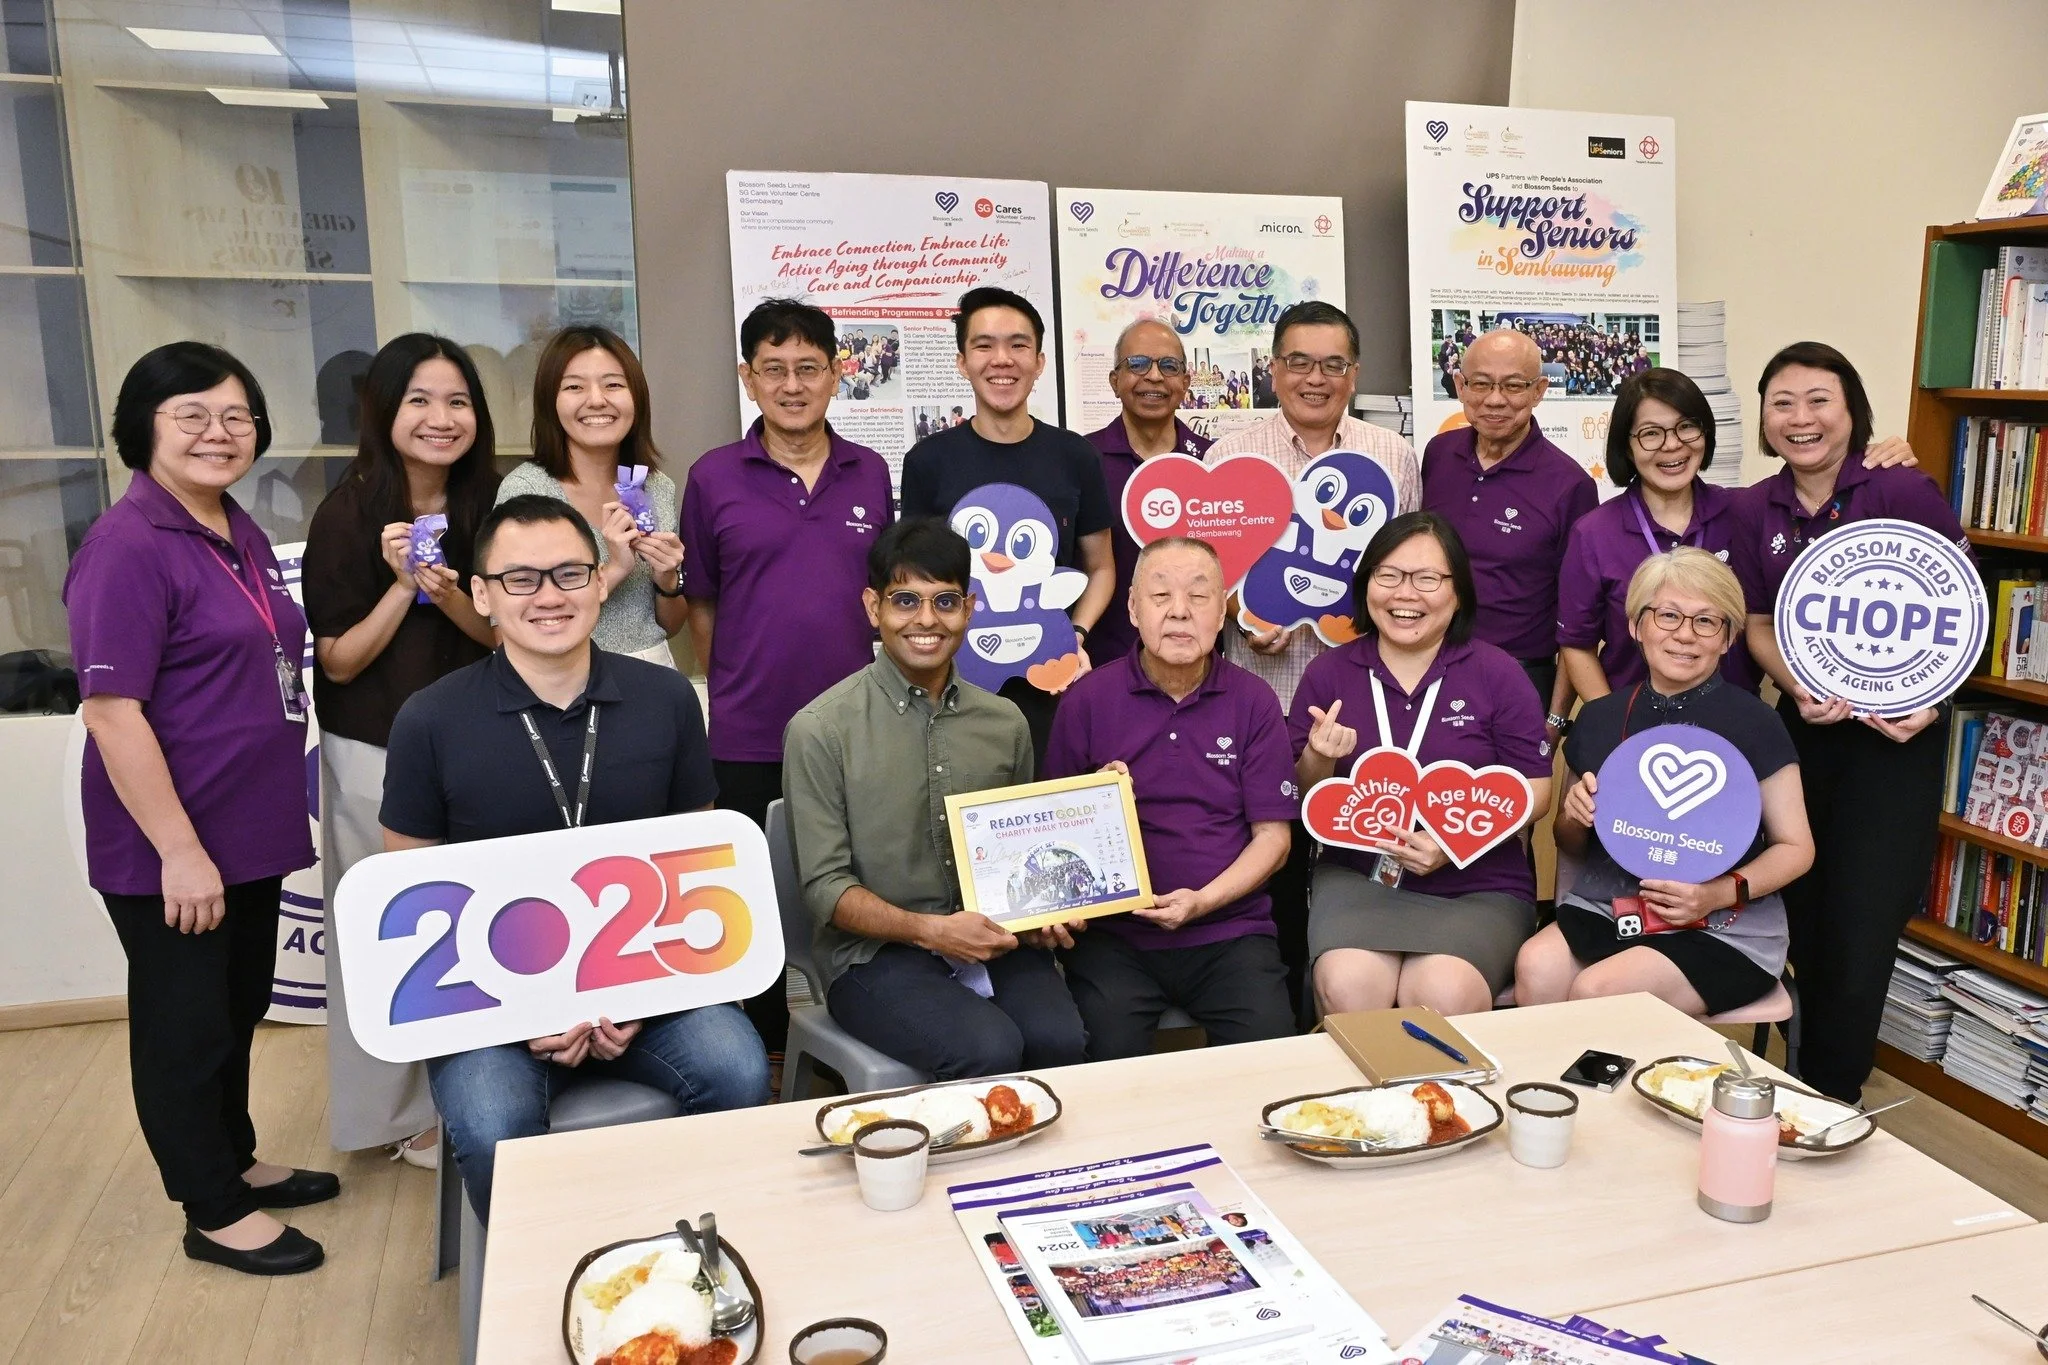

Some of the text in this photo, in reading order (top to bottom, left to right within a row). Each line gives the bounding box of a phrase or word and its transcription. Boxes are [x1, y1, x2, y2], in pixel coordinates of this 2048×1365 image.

[1524, 183, 1551, 191] Blossom
[1540, 175, 1566, 184] People's
[977, 204, 1022, 214] SG Cares
[1458, 182, 1587, 229] Support
[1260, 222, 1302, 233] micron
[1520, 218, 1638, 259] Seniors
[772, 233, 1010, 260] Embrace Connection, Embrace Life:
[1205, 246, 1265, 262] Making a
[778, 252, 1008, 279] Active Aging through Community
[1100, 248, 1272, 300] Difference
[1478, 246, 1616, 288] in Sembawang
[807, 278, 839, 292] Care
[843, 275, 873, 290] and
[832, 308, 879, 317] Befriending
[882, 309, 933, 317] Programmes
[1174, 291, 1295, 334] Togeth
[1148, 499, 1244, 517] SG Cares
[1186, 515, 1275, 528] Volunteer Centre
[1186, 529, 1242, 539] @Sembawang
[1510, 522, 1522, 531] Seeds
[1811, 541, 1958, 597] BLOSSOM SEEDS
[1795, 593, 1962, 647] CHOPE
[1803, 636, 1950, 692] ACTIVE AGEING CENTRE
[1986, 720, 2001, 739] A
[1332, 777, 1411, 831] Healthier
[1427, 786, 1515, 819] Age Well
[990, 804, 1096, 830] READY SET GOLD!
[996, 828, 1032, 839] CHARITY
[1033, 825, 1056, 833] WALK
[1072, 818, 1094, 826] UNITY
[1363, 807, 1398, 836] SG
[1442, 807, 1494, 837] SG
[2011, 824, 2023, 834] 50
[2014, 814, 2025, 825] SG
[1612, 819, 1724, 856] Blossom Seeds
[1647, 846, 1678, 866] 福善
[283, 927, 324, 955] AC
[378, 843, 752, 1026] 2025
[1038, 1241, 1080, 1252] 2024
